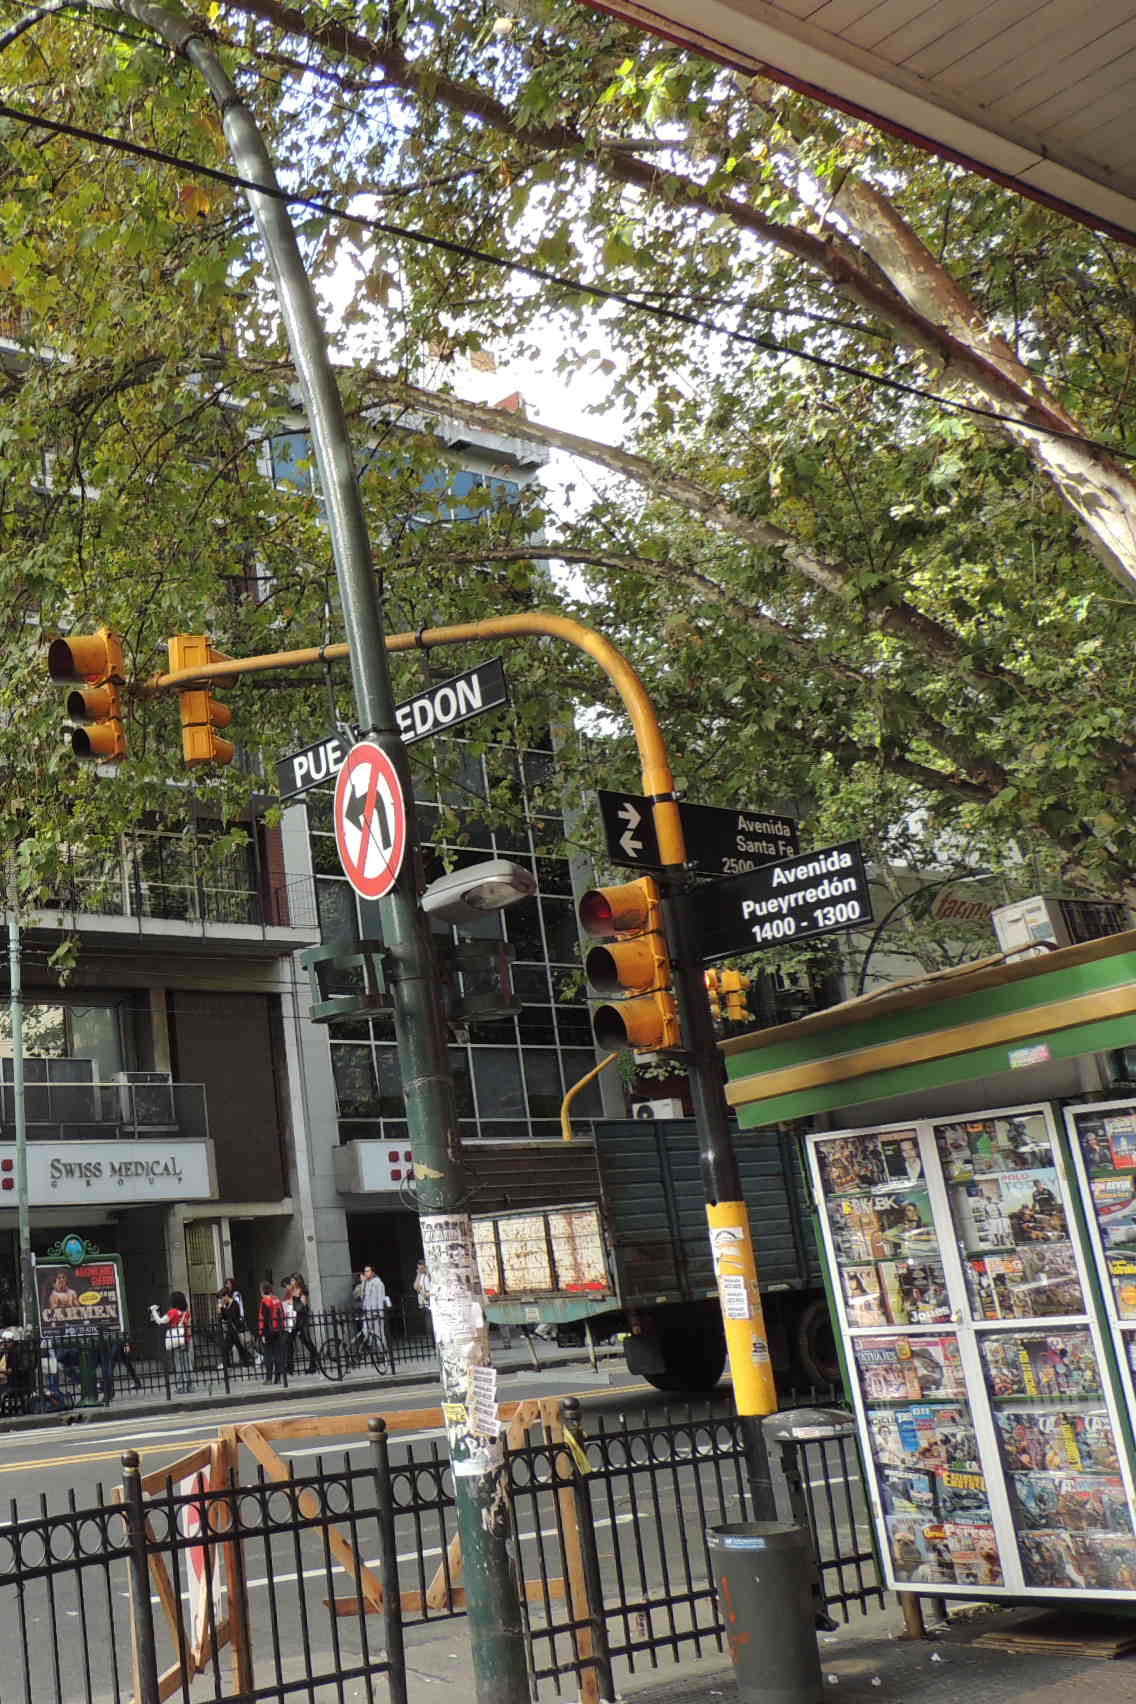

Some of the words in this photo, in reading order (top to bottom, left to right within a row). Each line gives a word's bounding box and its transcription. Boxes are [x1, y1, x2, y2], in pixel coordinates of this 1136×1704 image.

[737, 815, 791, 837] Avenida
[736, 835, 776, 856] Santa
[778, 840, 795, 857] Fe
[721, 857, 754, 874] 2500
[772, 851, 853, 887] Avenida
[742, 876, 857, 920] Pueyrredón
[752, 917, 796, 943] 1400
[813, 900, 861, 927] 1300
[50, 1158, 103, 1180] SWISS
[109, 1156, 183, 1177] MEDICAL
